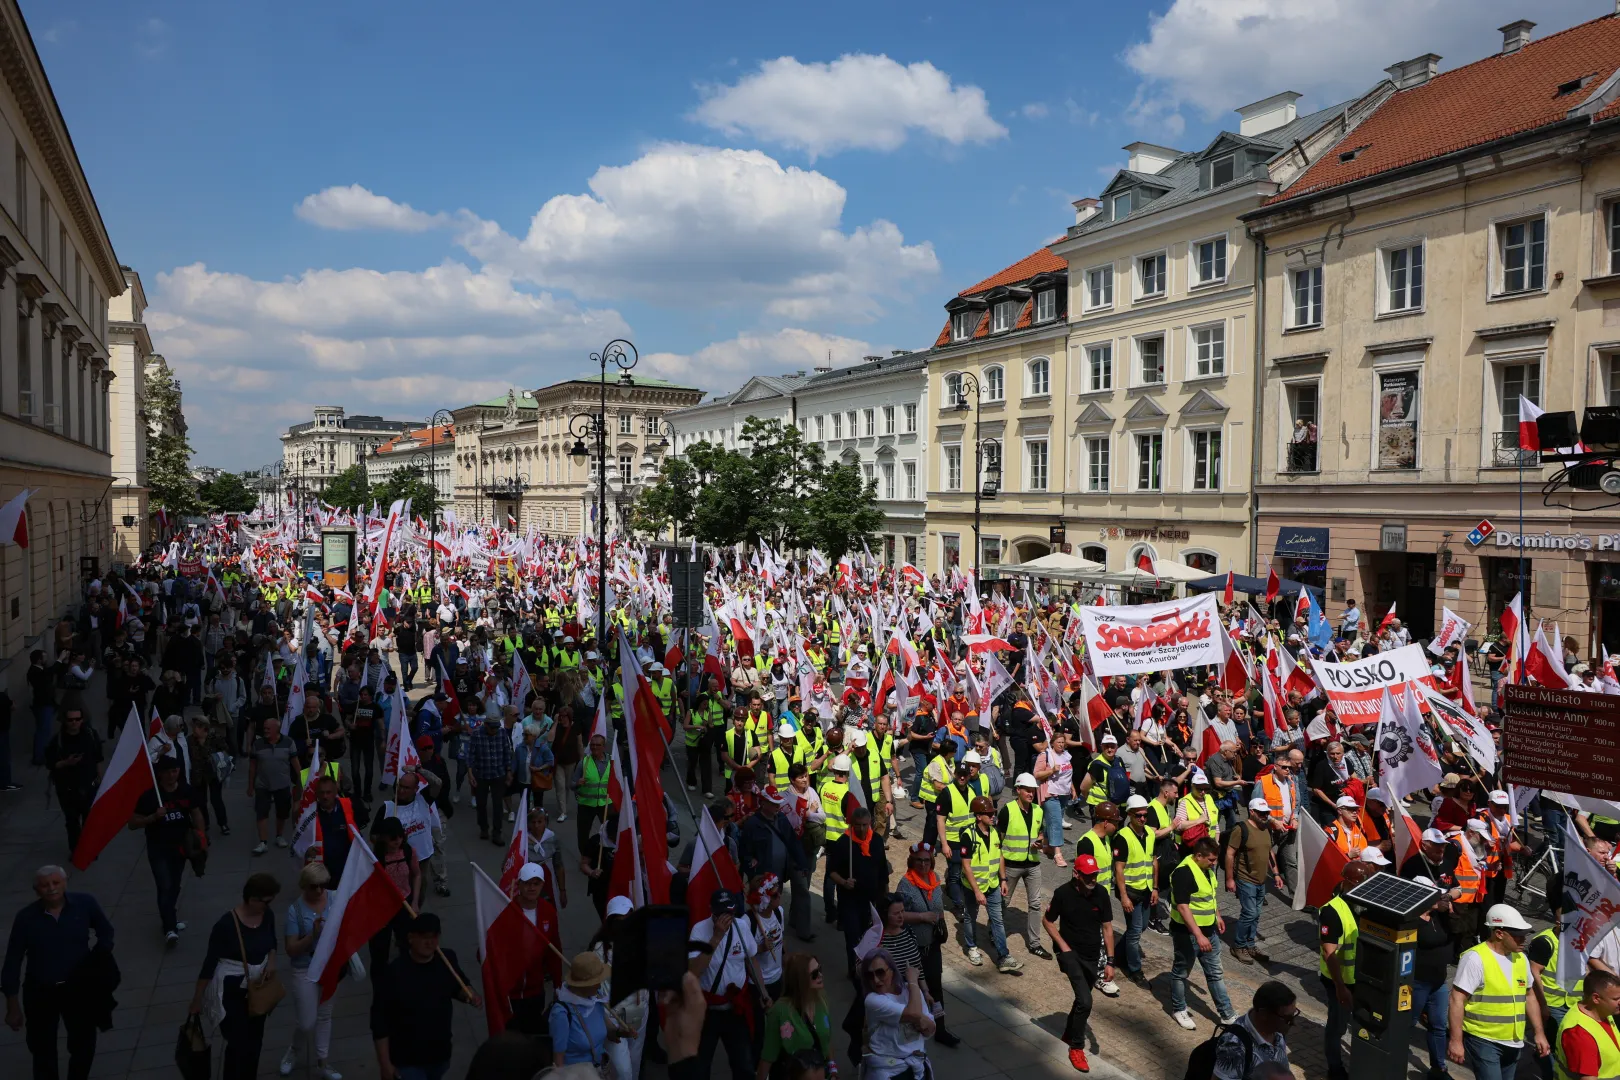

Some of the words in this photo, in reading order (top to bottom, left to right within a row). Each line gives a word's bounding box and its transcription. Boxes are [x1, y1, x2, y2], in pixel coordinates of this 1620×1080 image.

[1496, 530, 1592, 549] Domino's
[1122, 648, 1151, 658] Knurów
[1158, 642, 1210, 654] Szczygłowice
[1125, 657, 1144, 665] Ruch
[1325, 659, 1405, 689] POLSKO,
[1508, 687, 1537, 700] Stare
[1539, 691, 1581, 706] Miasto
[1590, 700, 1607, 708] 1100
[1509, 704, 1543, 718] Kościół
[1545, 710, 1561, 720] św.
[1563, 712, 1589, 727] Anny
[1594, 718, 1607, 726] 900
[1507, 719, 1536, 727] Muzeum
[1536, 722, 1573, 734] Karykatury
[1508, 725, 1519, 733] The
[1519, 728, 1546, 737] Museum
[1554, 732, 1588, 743] Caricature
[1594, 737, 1607, 745] 700
[1507, 734, 1522, 742] Pałac
[1525, 737, 1564, 749] Prezydencki
[1507, 752, 1546, 763] Ministerstwo
[1546, 756, 1570, 768] Kultury
[1520, 744, 1555, 755] Presidential
[1557, 749, 1579, 759] Palace
[1592, 754, 1606, 763] 550
[1509, 759, 1546, 772] Dziedzictwa
[1547, 766, 1589, 779] Narodowego
[1591, 772, 1605, 781] 500
[1506, 774, 1531, 784] Akademia
[1531, 776, 1546, 787] Sztuk
[1547, 780, 1571, 791] Pięknych
[1592, 787, 1605, 796] 100
[1401, 951, 1412, 972] P
